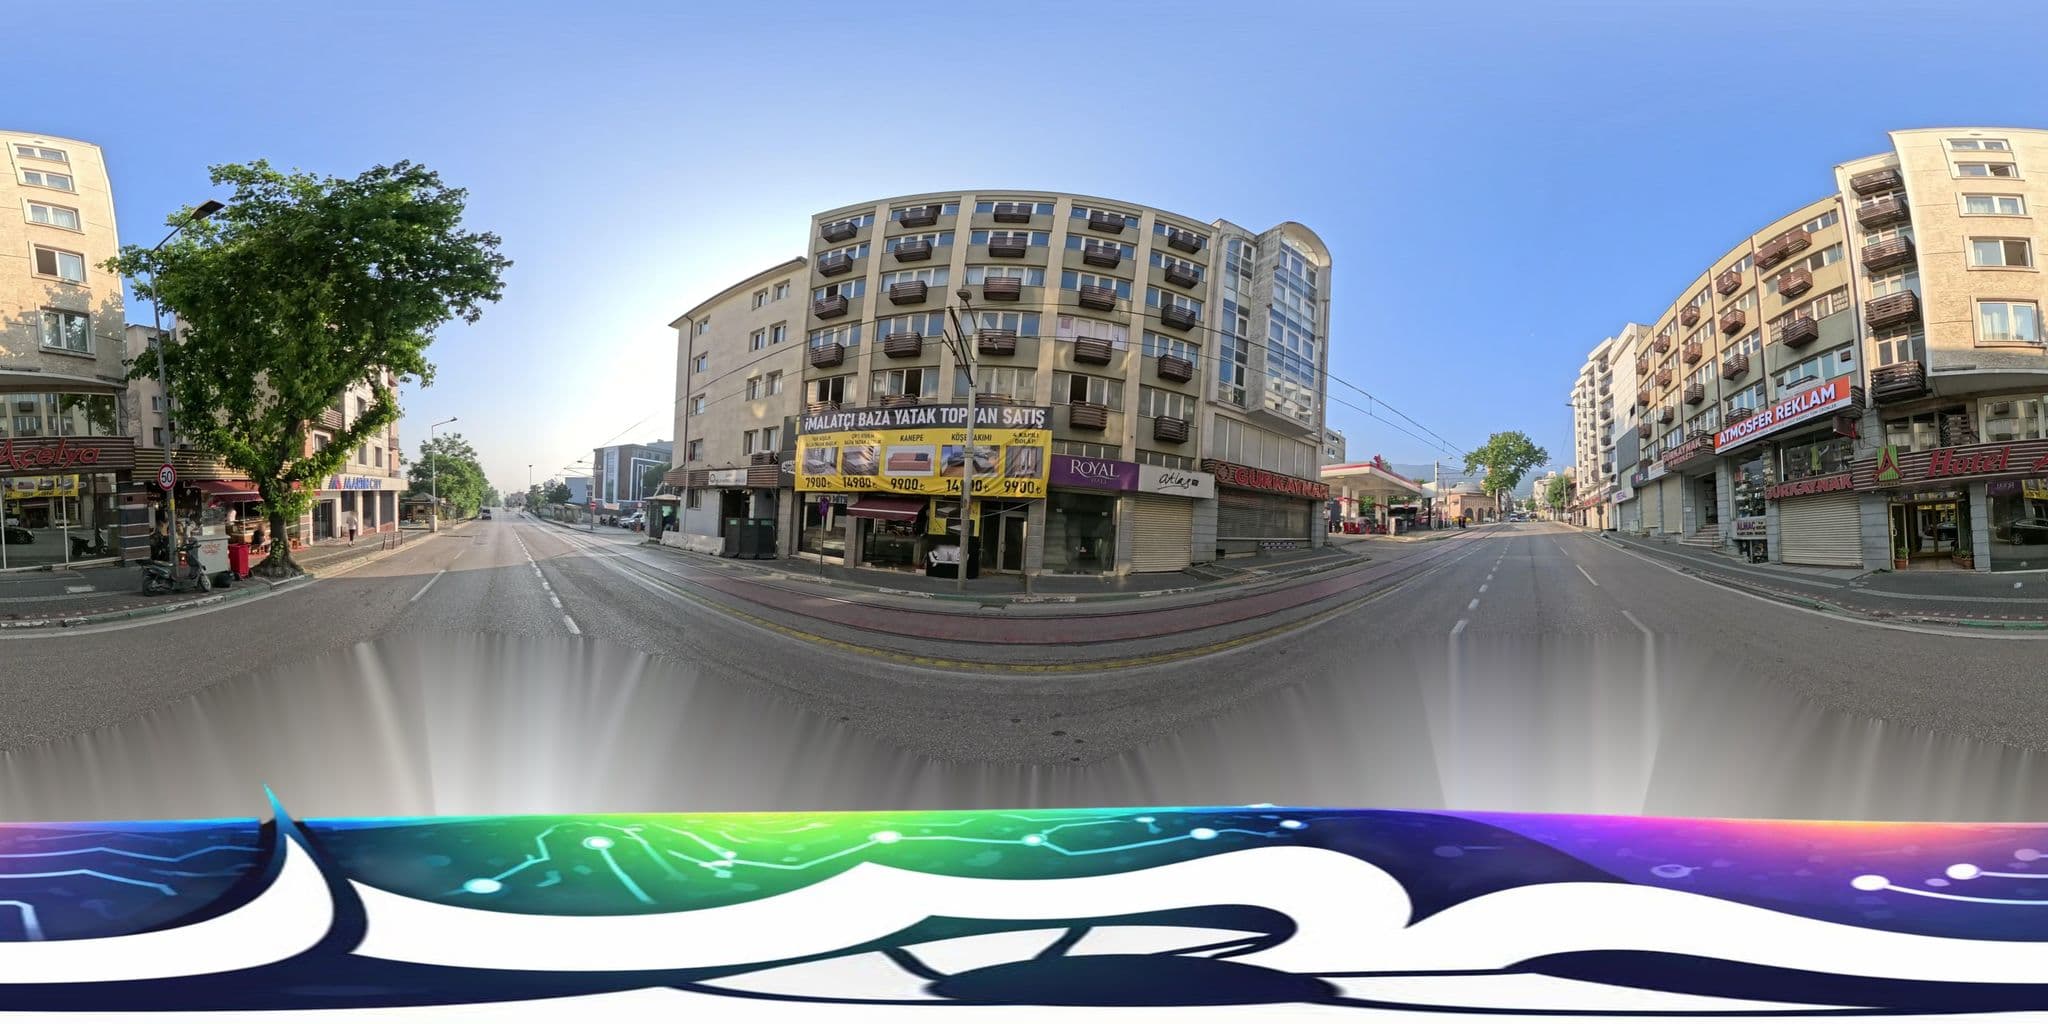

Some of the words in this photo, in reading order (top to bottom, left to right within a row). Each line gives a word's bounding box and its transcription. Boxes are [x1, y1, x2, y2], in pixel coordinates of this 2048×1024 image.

[858, 411, 890, 426] BAZA
[894, 408, 937, 425] YATAK
[1002, 408, 1046, 429] SATIŞ
[1719, 410, 1773, 445] ATMOSFER
[1775, 383, 1836, 421] REKLAM
[900, 434, 924, 442] KANEPE
[1071, 459, 1120, 479] ROYAL
[1927, 446, 2011, 478] Hotel
[161, 470, 173, 483] 50
